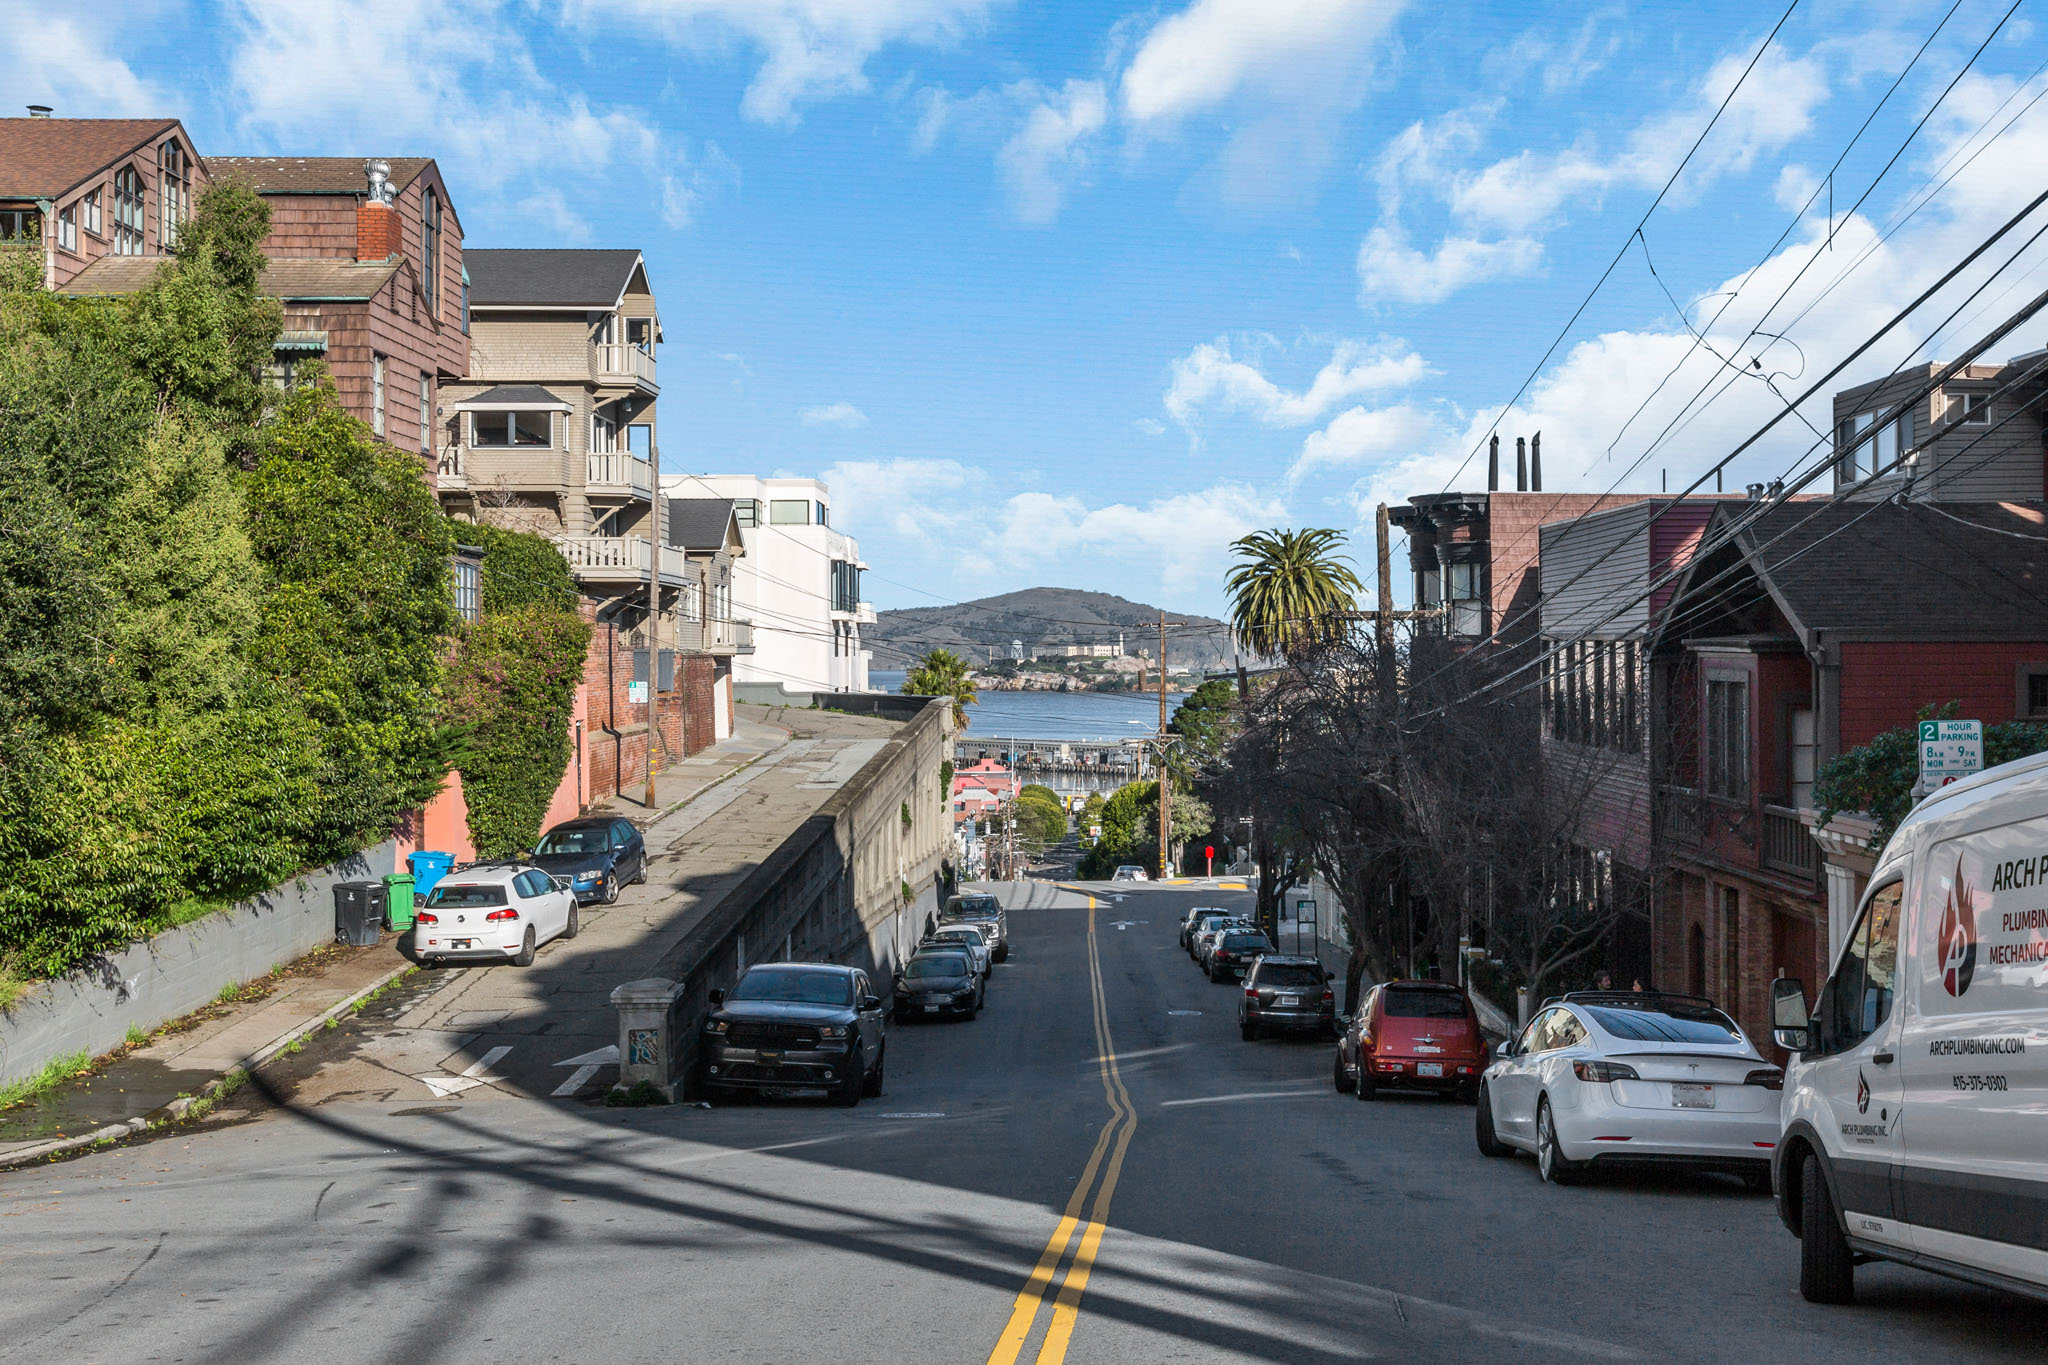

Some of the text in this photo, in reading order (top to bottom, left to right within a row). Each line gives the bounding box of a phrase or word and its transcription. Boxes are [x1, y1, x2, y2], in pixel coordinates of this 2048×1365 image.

[1924, 725, 1935, 739] 2
[1947, 723, 1972, 731] HOUR
[1941, 733, 1978, 741] PARKING
[1963, 759, 1976, 767] SAT
[1992, 857, 2036, 892] ARCH
[2003, 908, 2048, 932] PLUMBIN
[1929, 1038, 2025, 1056] ARCHPLUMBINGINC.COM
[1953, 1075, 2008, 1091] 415-375-0302
[1841, 1124, 1853, 1135] ARCH
[1854, 1124, 1878, 1136] PLUMBING
